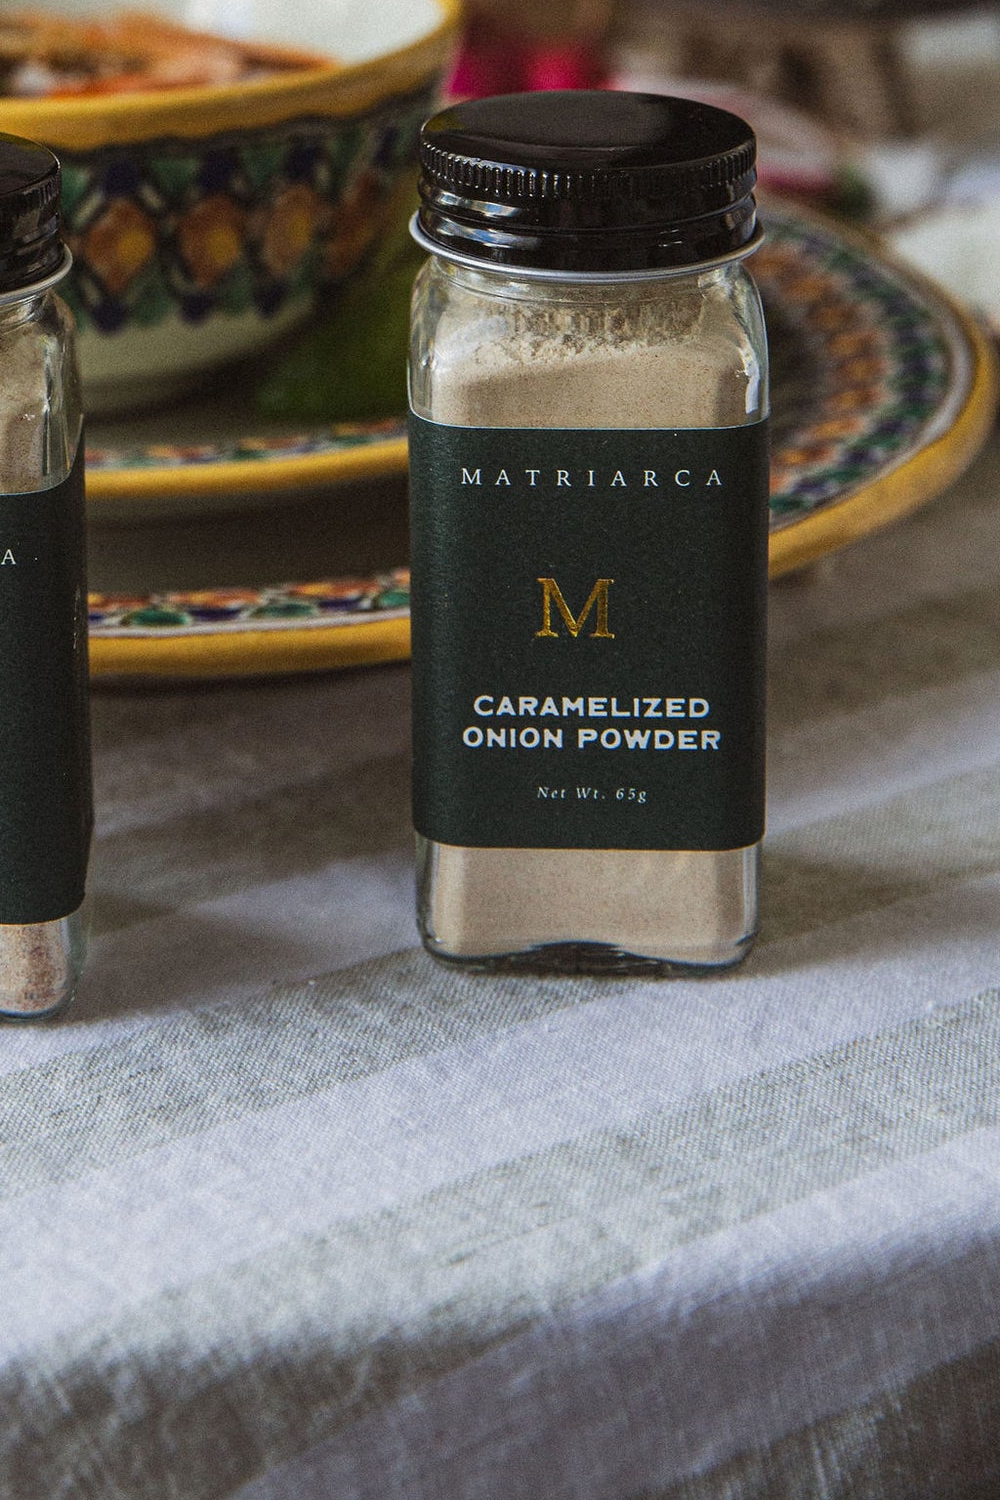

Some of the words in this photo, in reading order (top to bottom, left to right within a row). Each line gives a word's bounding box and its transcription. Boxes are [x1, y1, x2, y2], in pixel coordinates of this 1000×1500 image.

[460, 466, 723, 488] MATRIARCA
[534, 576, 617, 640] M
[472, 693, 711, 720] CARAMELIZED
[461, 725, 564, 750] ONION
[576, 726, 722, 752] POWDER
[536, 785, 567, 800] Net
[575, 786, 607, 801] Wt.
[614, 786, 648, 805] 65g
